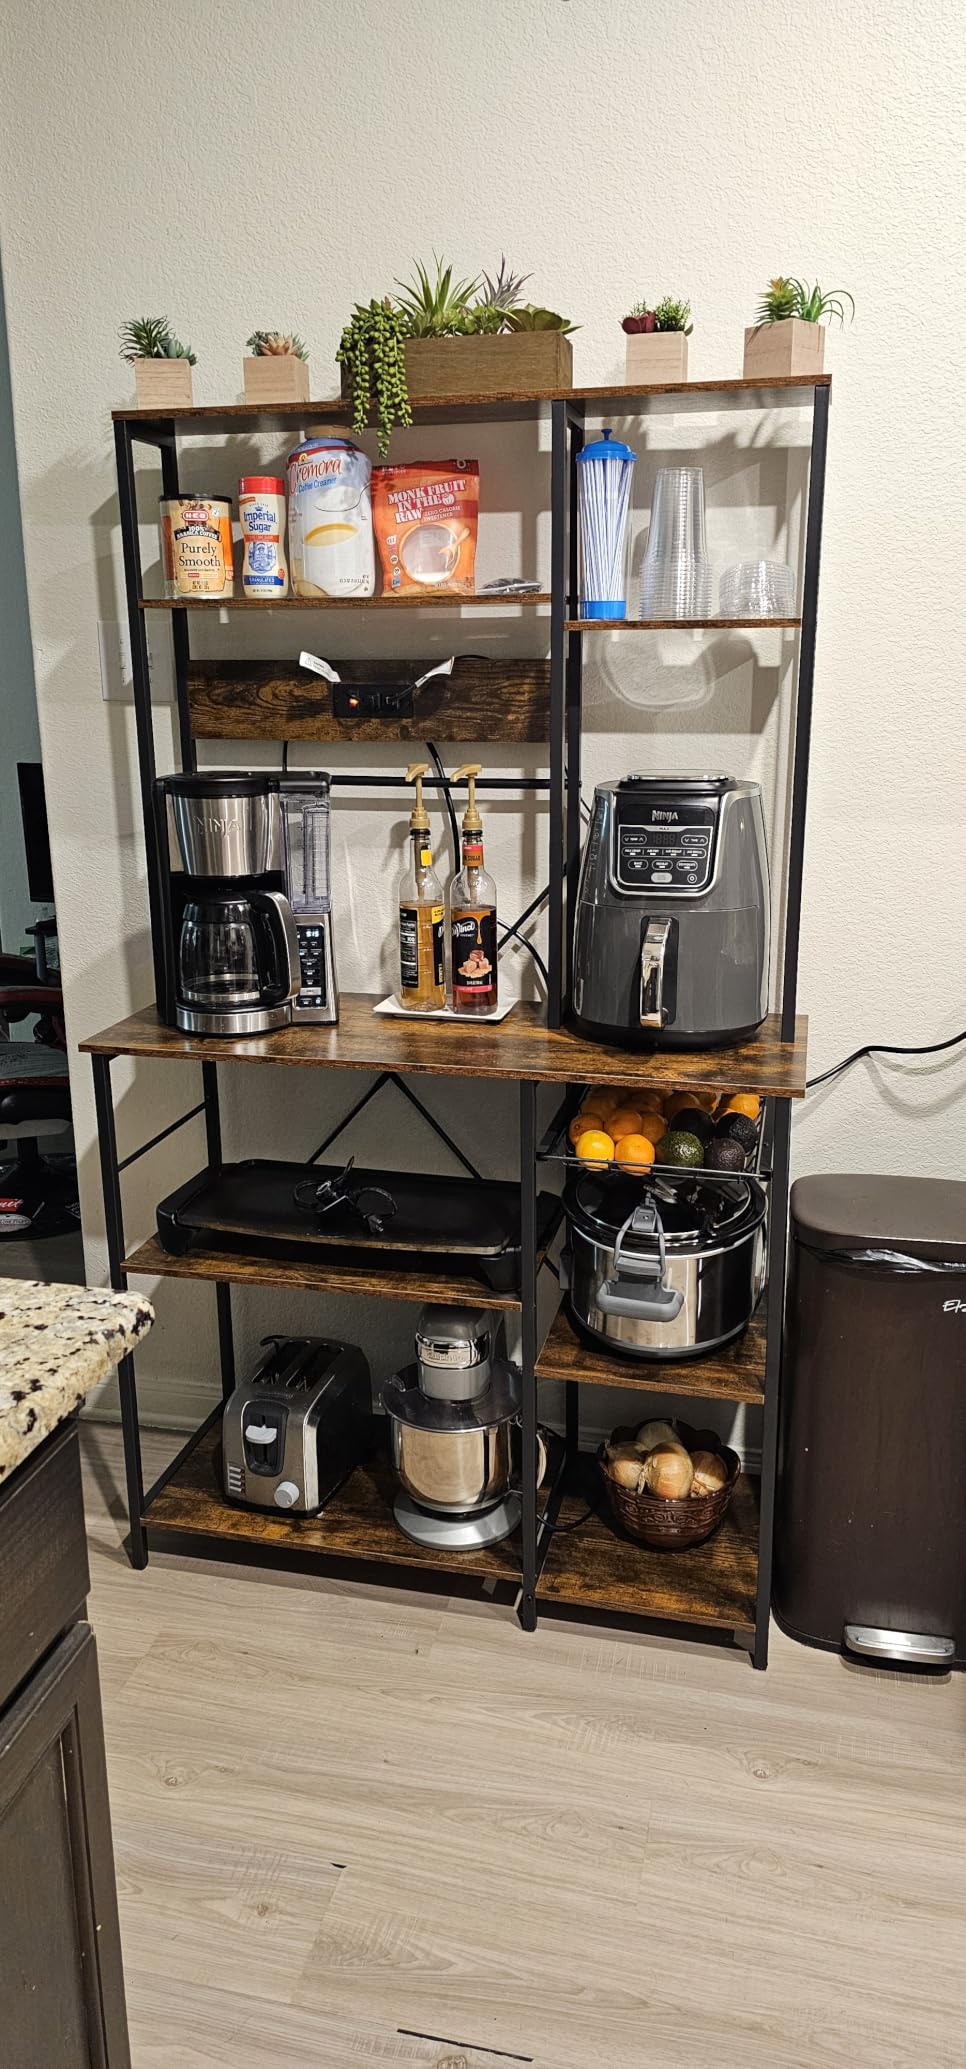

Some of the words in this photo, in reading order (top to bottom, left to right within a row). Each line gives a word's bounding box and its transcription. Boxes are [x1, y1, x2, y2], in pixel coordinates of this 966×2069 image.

[288, 458, 342, 495] Cremora
[388, 487, 426, 505] MONK
[427, 480, 466, 498] FRUIT
[397, 500, 414, 512] IN
[413, 494, 442, 508] THE
[243, 510, 276, 523] Imperial
[395, 508, 423, 524] RAW
[248, 521, 272, 533] Sugar
[181, 542, 217, 557] Purely
[178, 556, 221, 567] Smooth
[651, 810, 678, 823] NINJA
